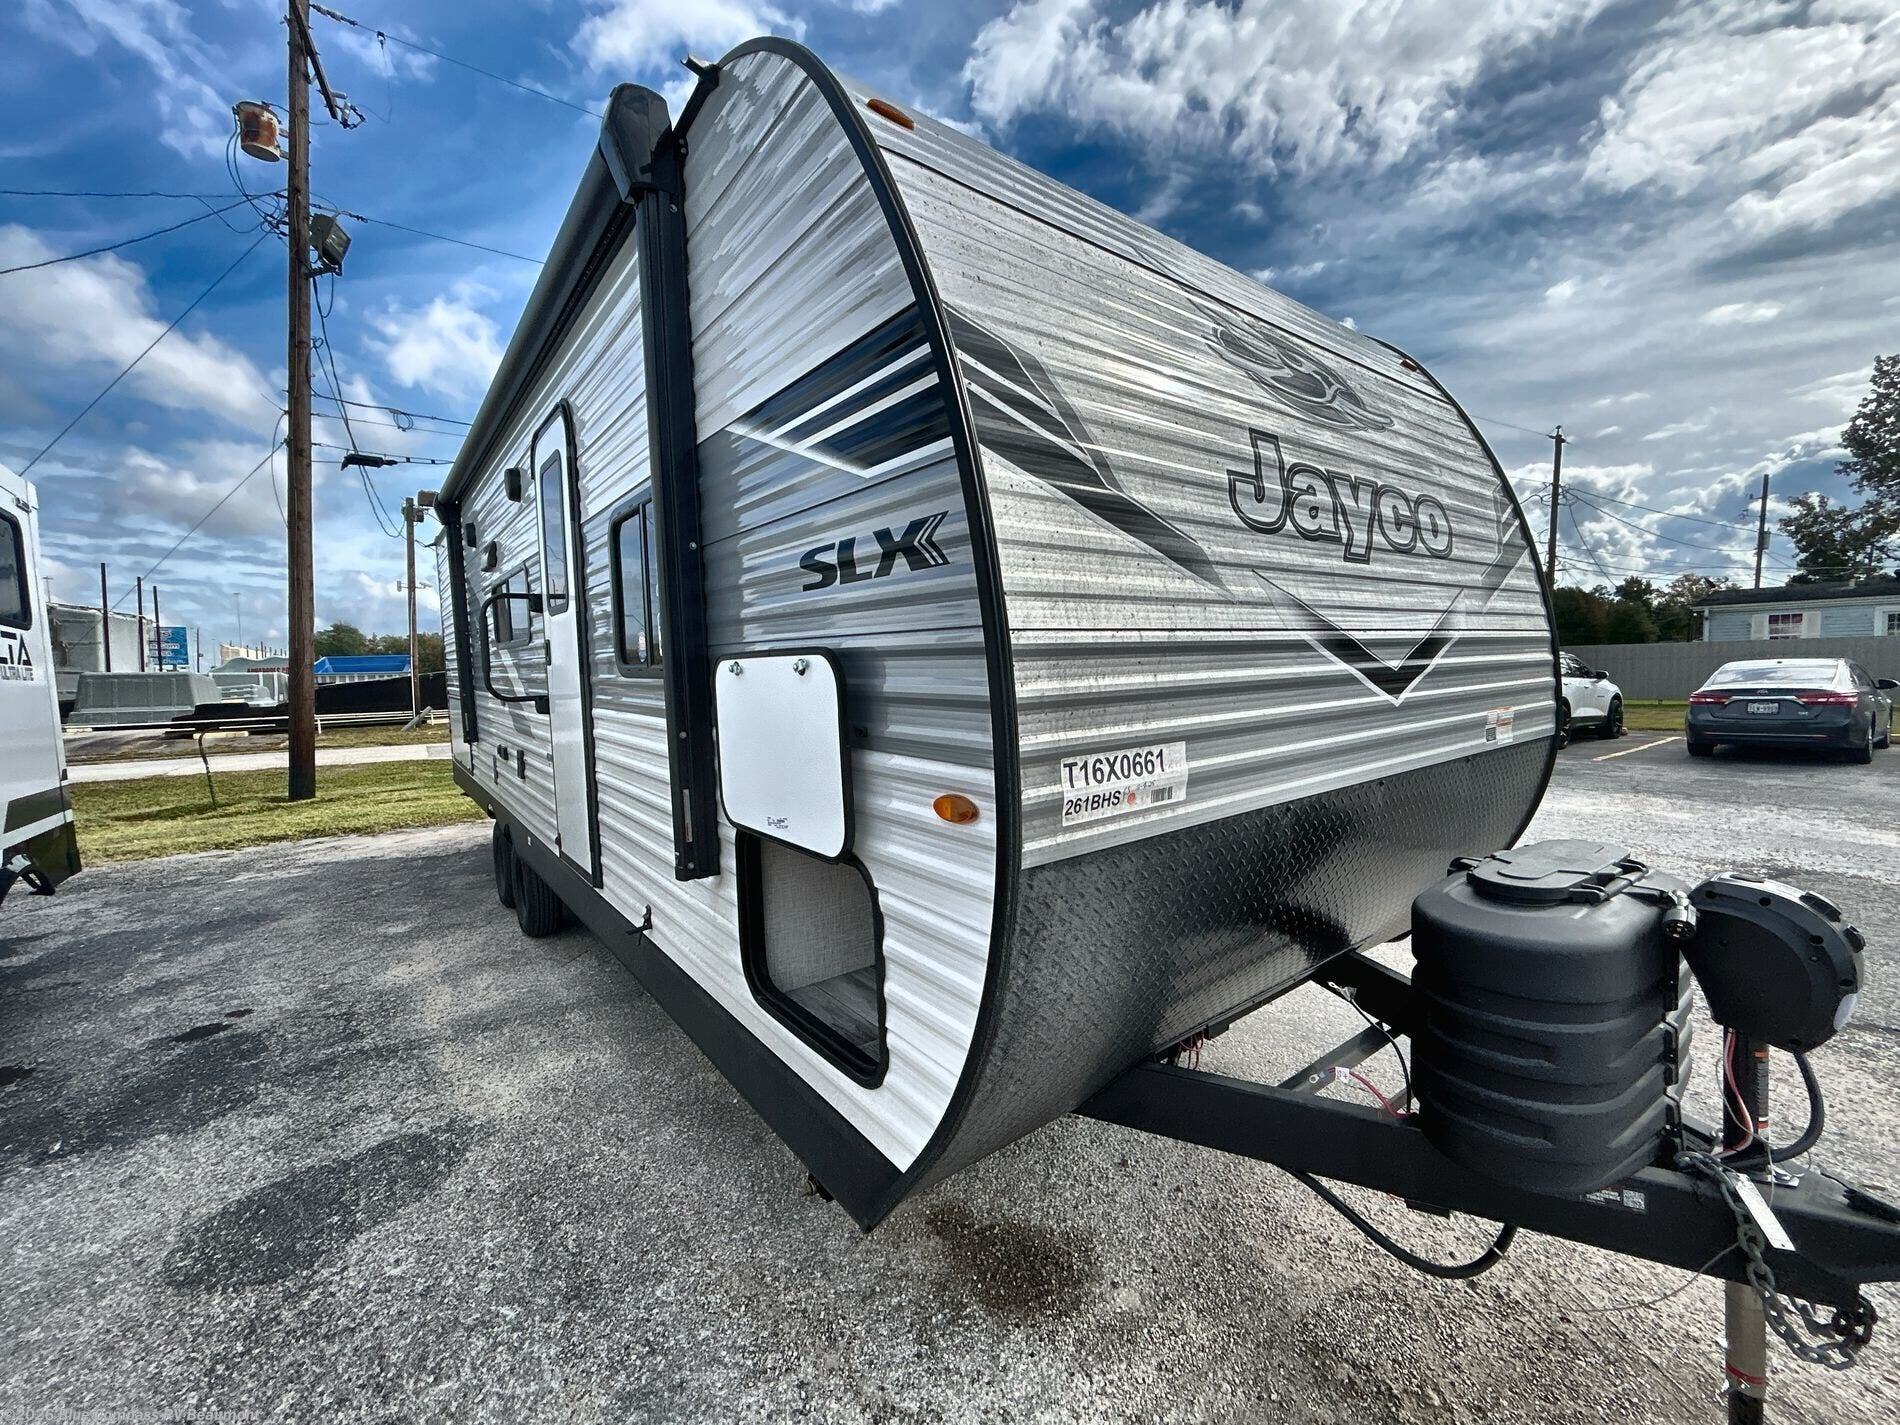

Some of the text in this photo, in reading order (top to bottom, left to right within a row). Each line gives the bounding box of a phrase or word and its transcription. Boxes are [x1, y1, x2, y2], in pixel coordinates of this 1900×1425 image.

[1226, 427, 1453, 565] Jayco
[799, 510, 951, 592] SLX
[1063, 749, 1165, 789] T16X0661
[1064, 790, 1122, 817] 261BHS
